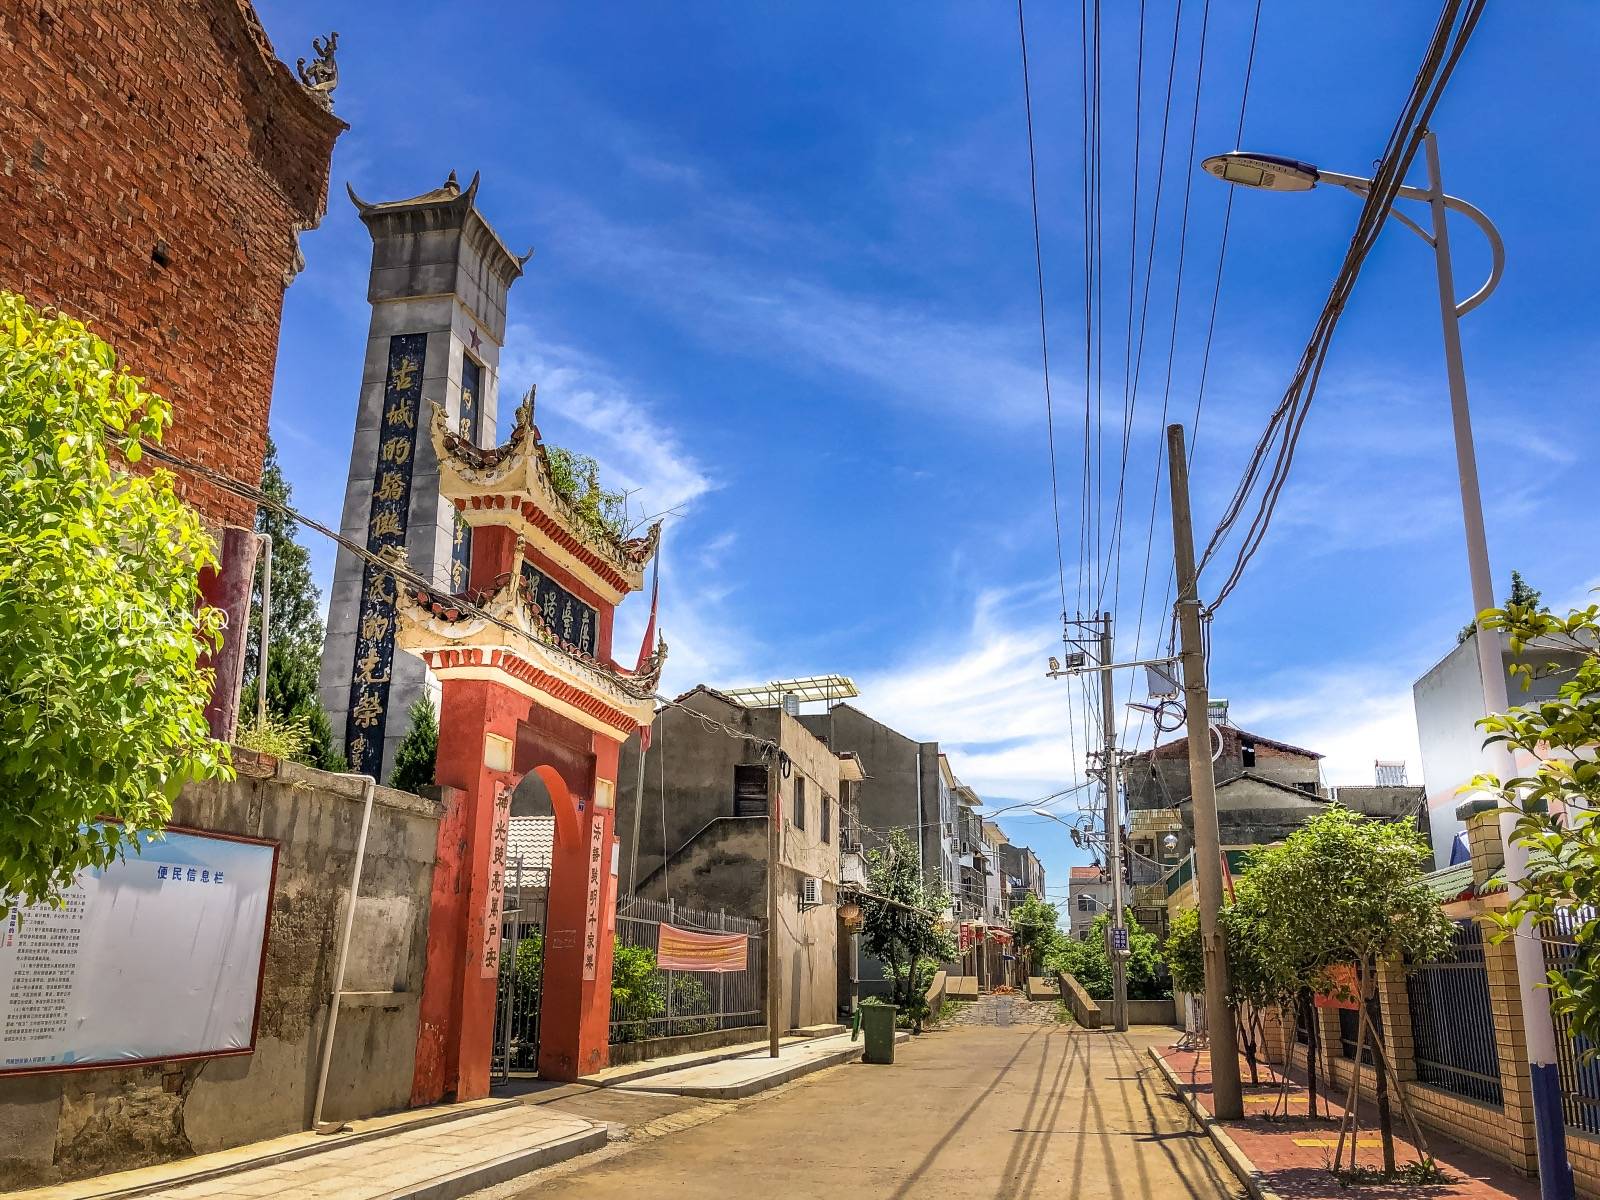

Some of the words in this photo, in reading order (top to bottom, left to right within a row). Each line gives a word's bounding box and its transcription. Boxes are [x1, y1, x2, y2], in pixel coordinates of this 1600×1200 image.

[157, 865, 224, 884] 便民信息栏
